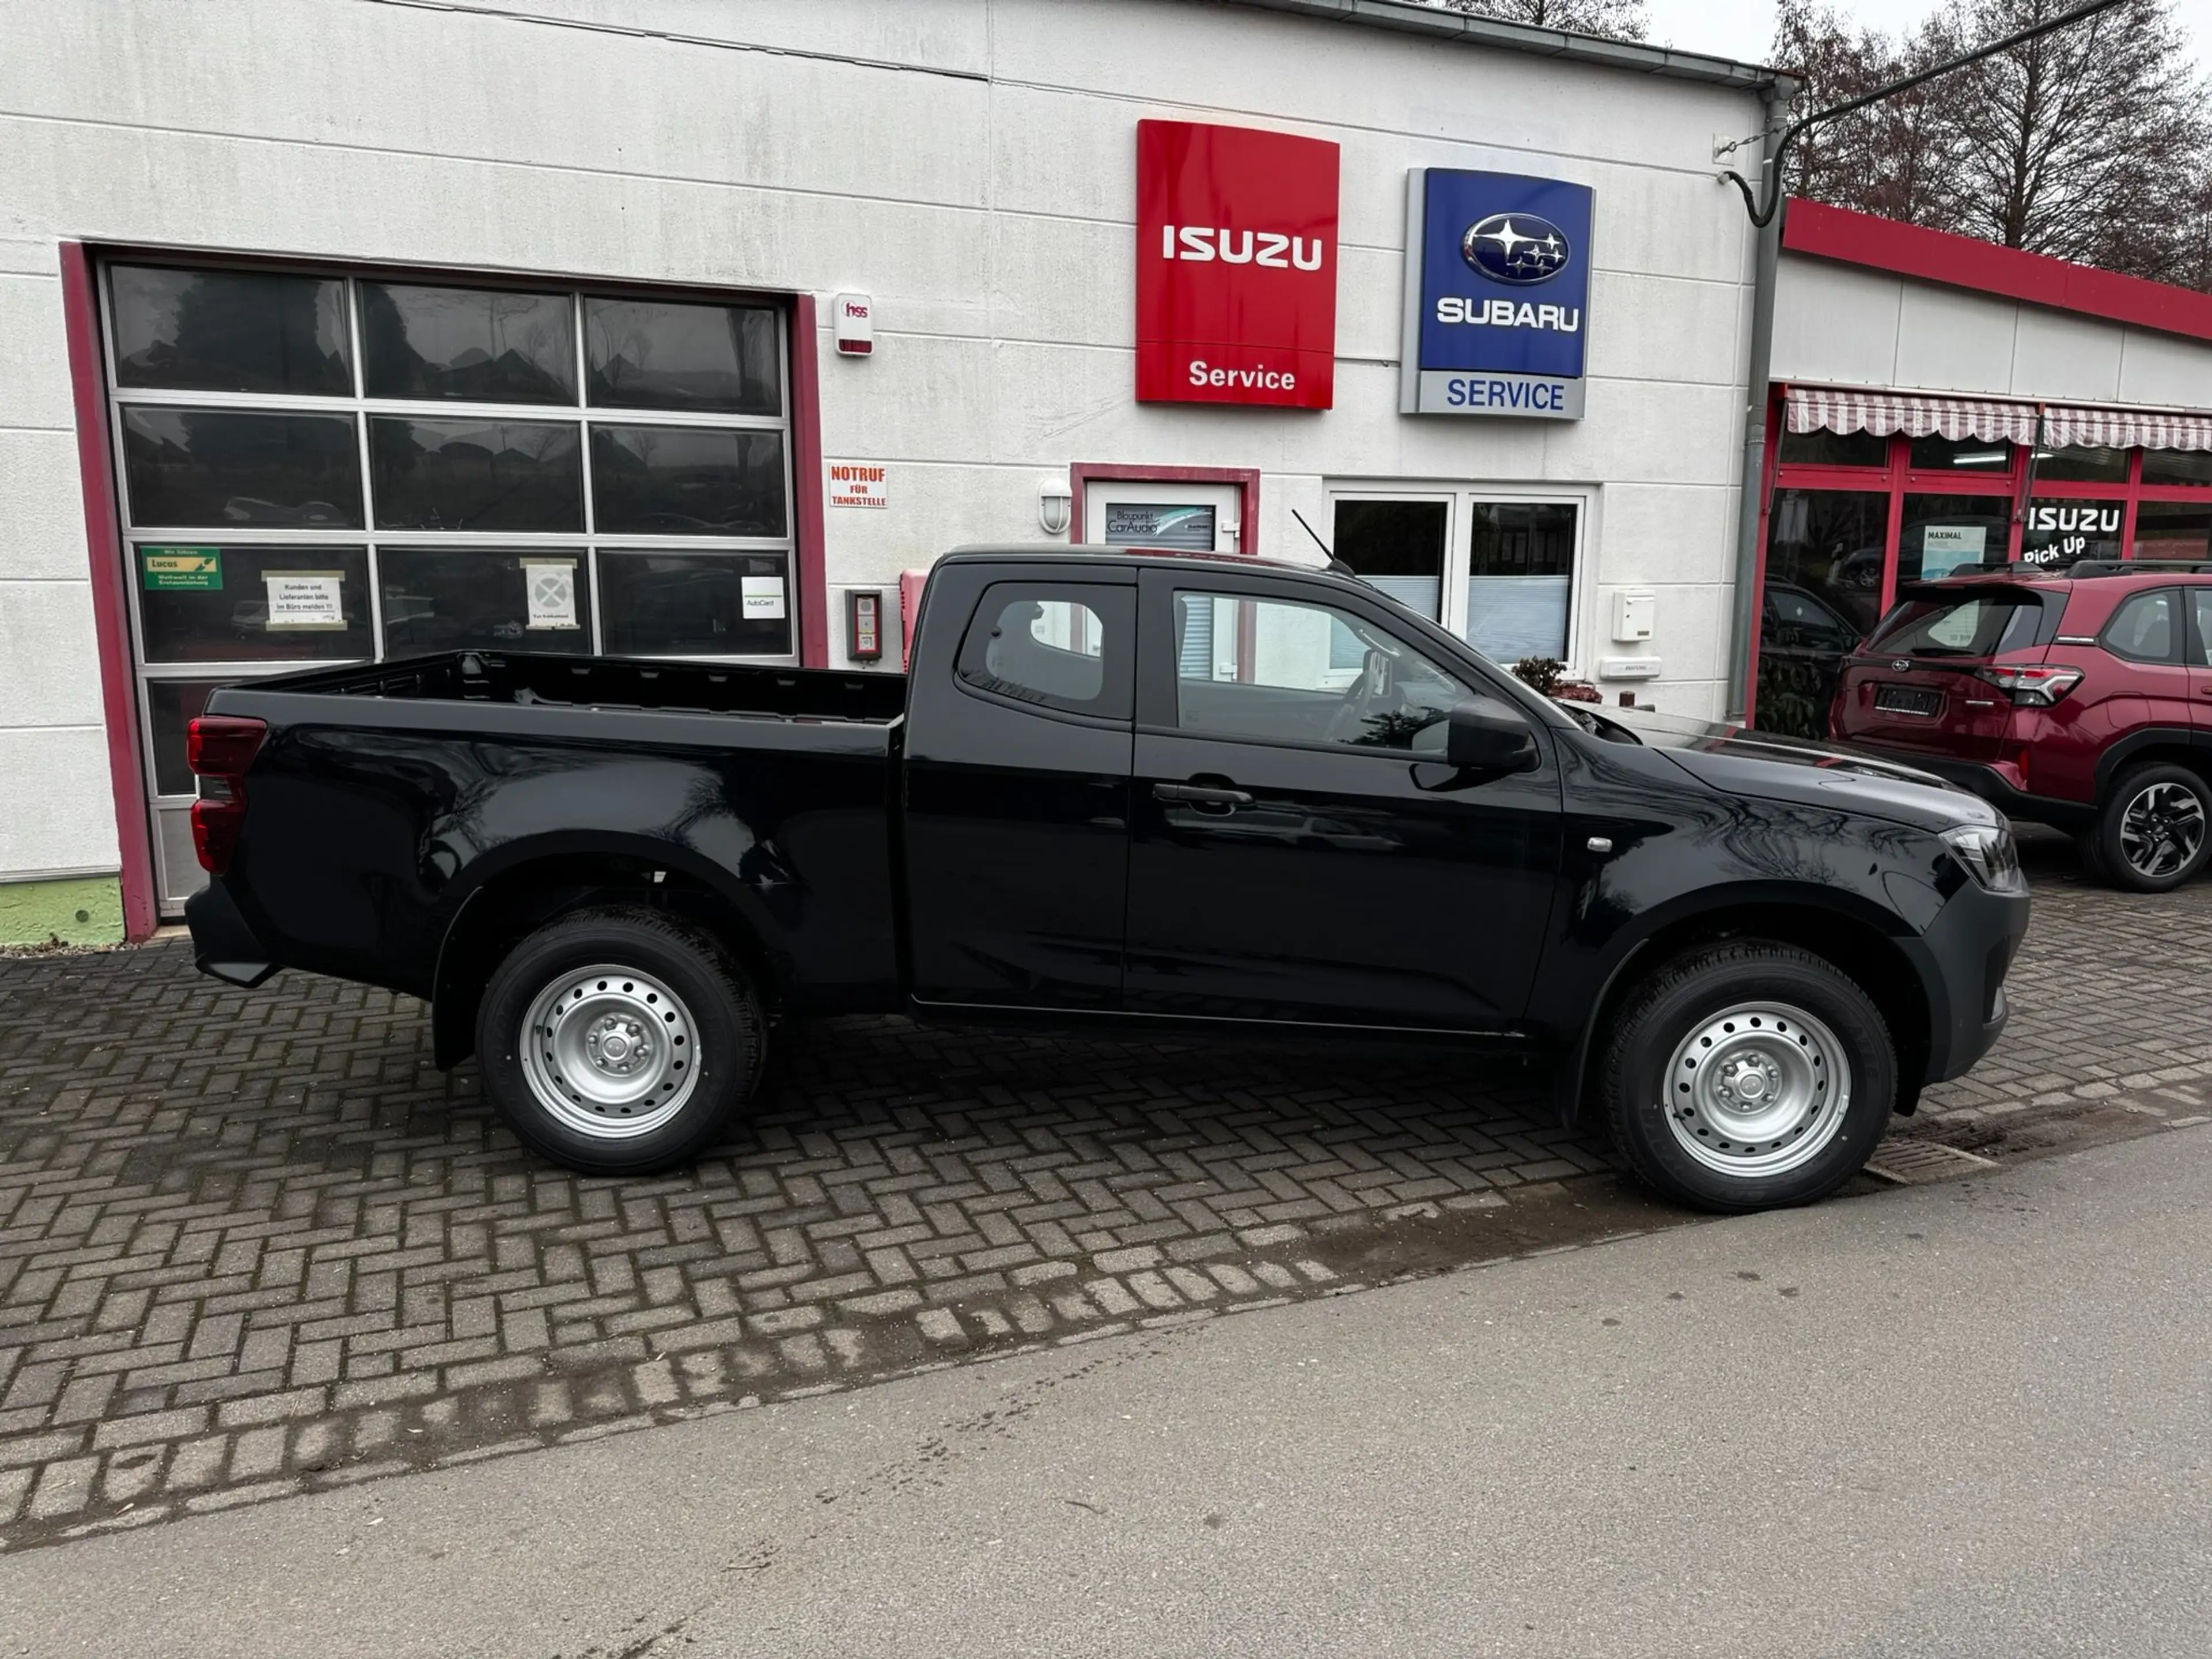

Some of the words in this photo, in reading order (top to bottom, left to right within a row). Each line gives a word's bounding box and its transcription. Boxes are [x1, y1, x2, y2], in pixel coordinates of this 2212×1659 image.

[1162, 225, 1323, 271] ISUZU
[846, 302, 868, 319] hss
[1437, 297, 1579, 332] SUBARU
[1189, 361, 1296, 390] Service
[1447, 378, 1565, 411] SERVICE
[831, 465, 885, 482] NOTRUF
[850, 484, 868, 494] FÜR
[832, 496, 887, 506] TANKSTELLE
[1108, 520, 1158, 533] CarAudio
[2028, 507, 2120, 532] ISUZU
[1928, 531, 1963, 540] MAXIMAL
[2063, 536, 2086, 555] Up
[151, 559, 178, 568] Lucas
